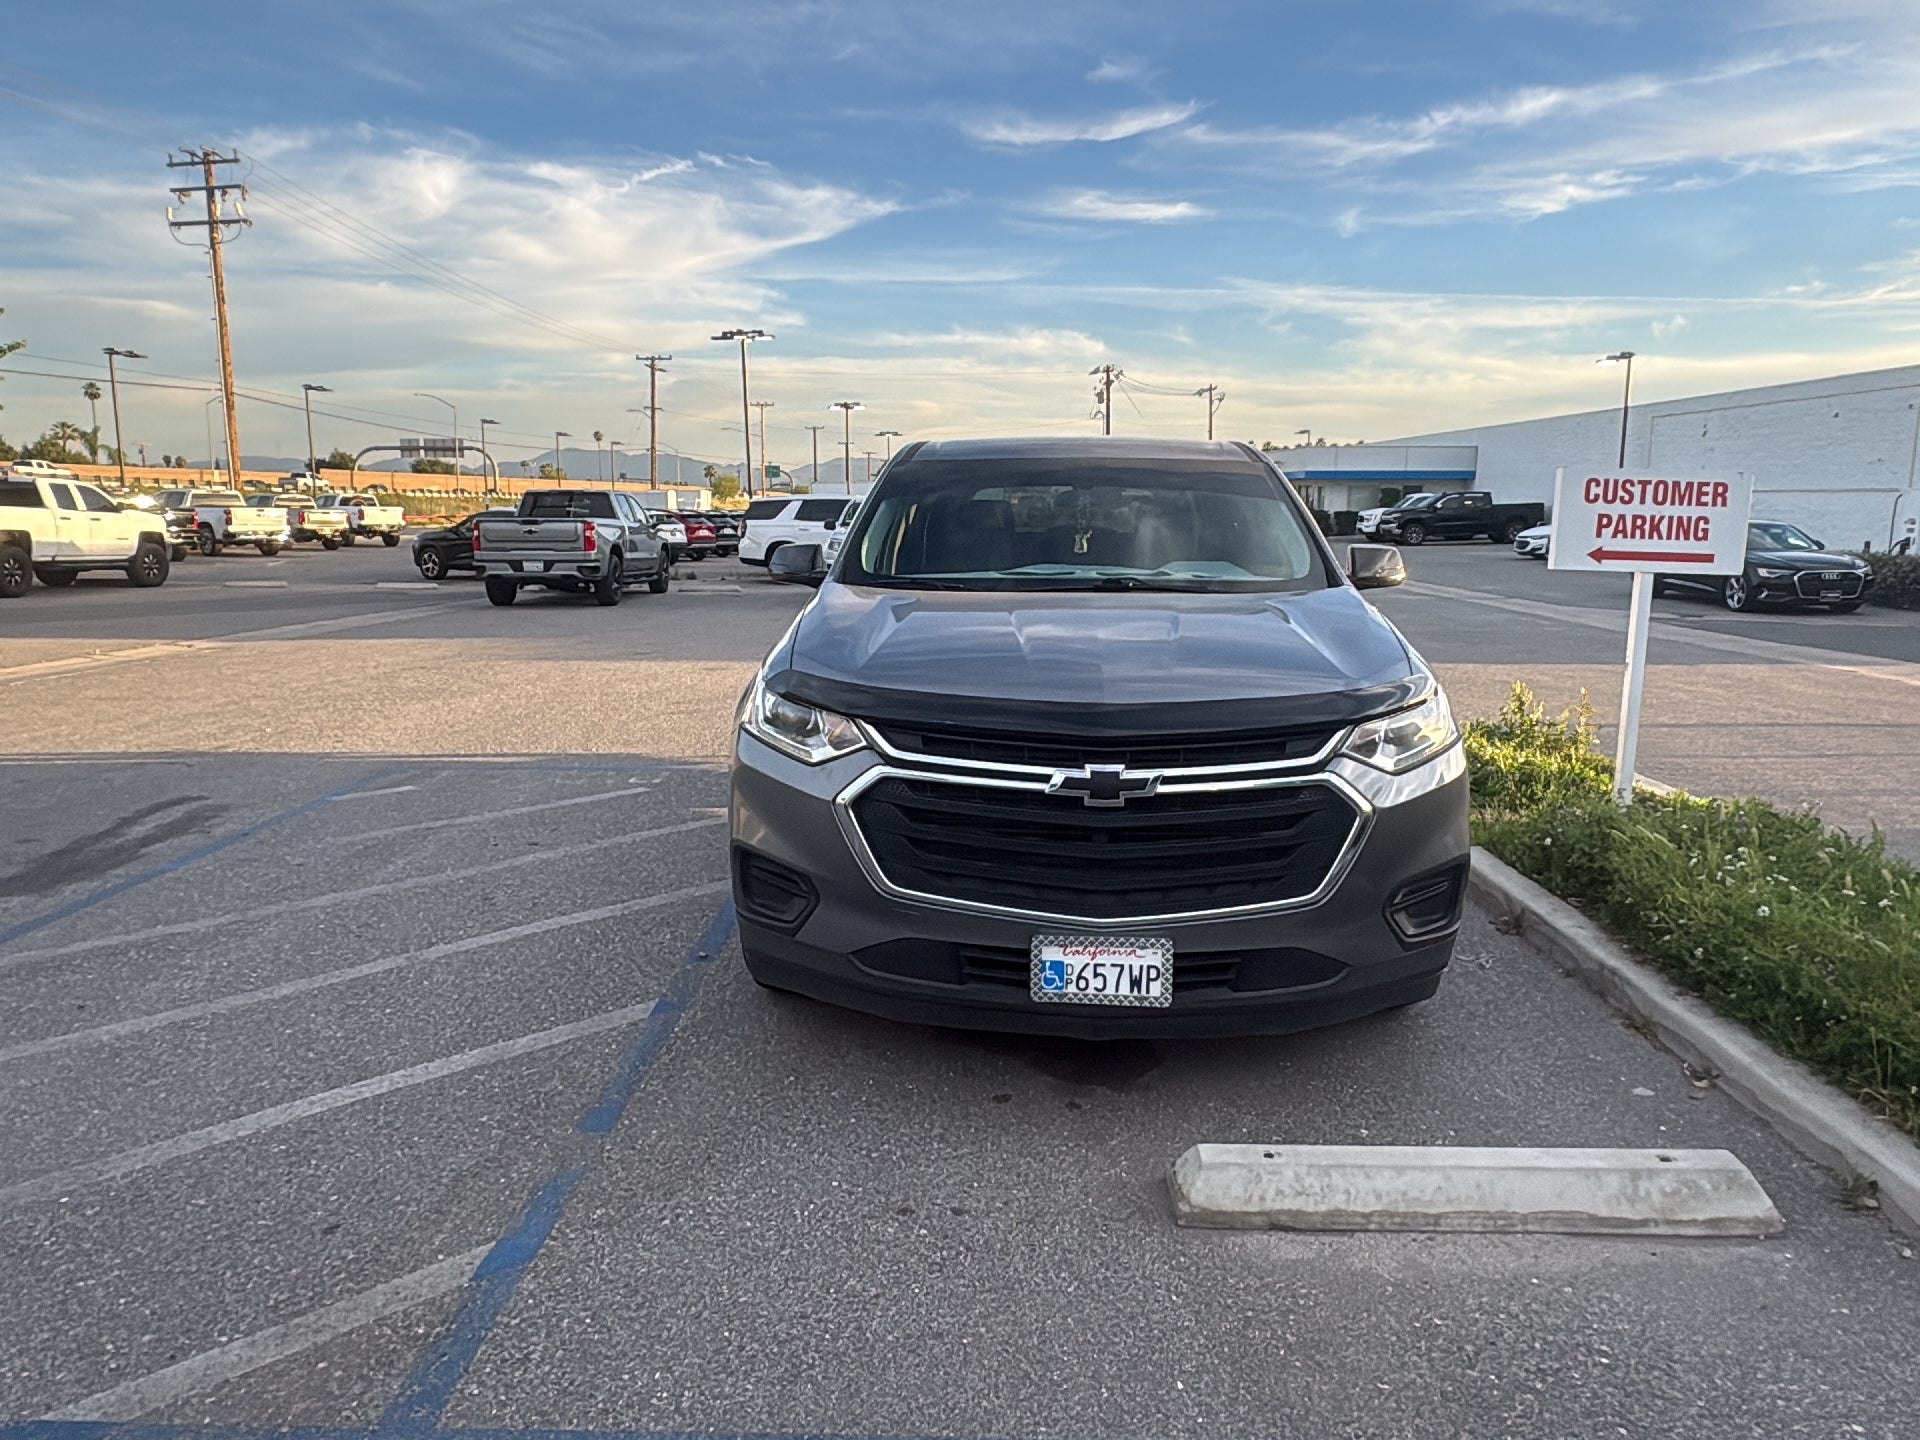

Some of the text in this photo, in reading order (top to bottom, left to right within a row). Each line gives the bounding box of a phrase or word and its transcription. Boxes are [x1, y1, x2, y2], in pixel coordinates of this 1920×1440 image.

[1584, 477, 1729, 507] CUSTOMER
[1595, 513, 1710, 542] PARKING
[1062, 944, 1146, 961] California
[1075, 962, 1161, 995] 657WP
